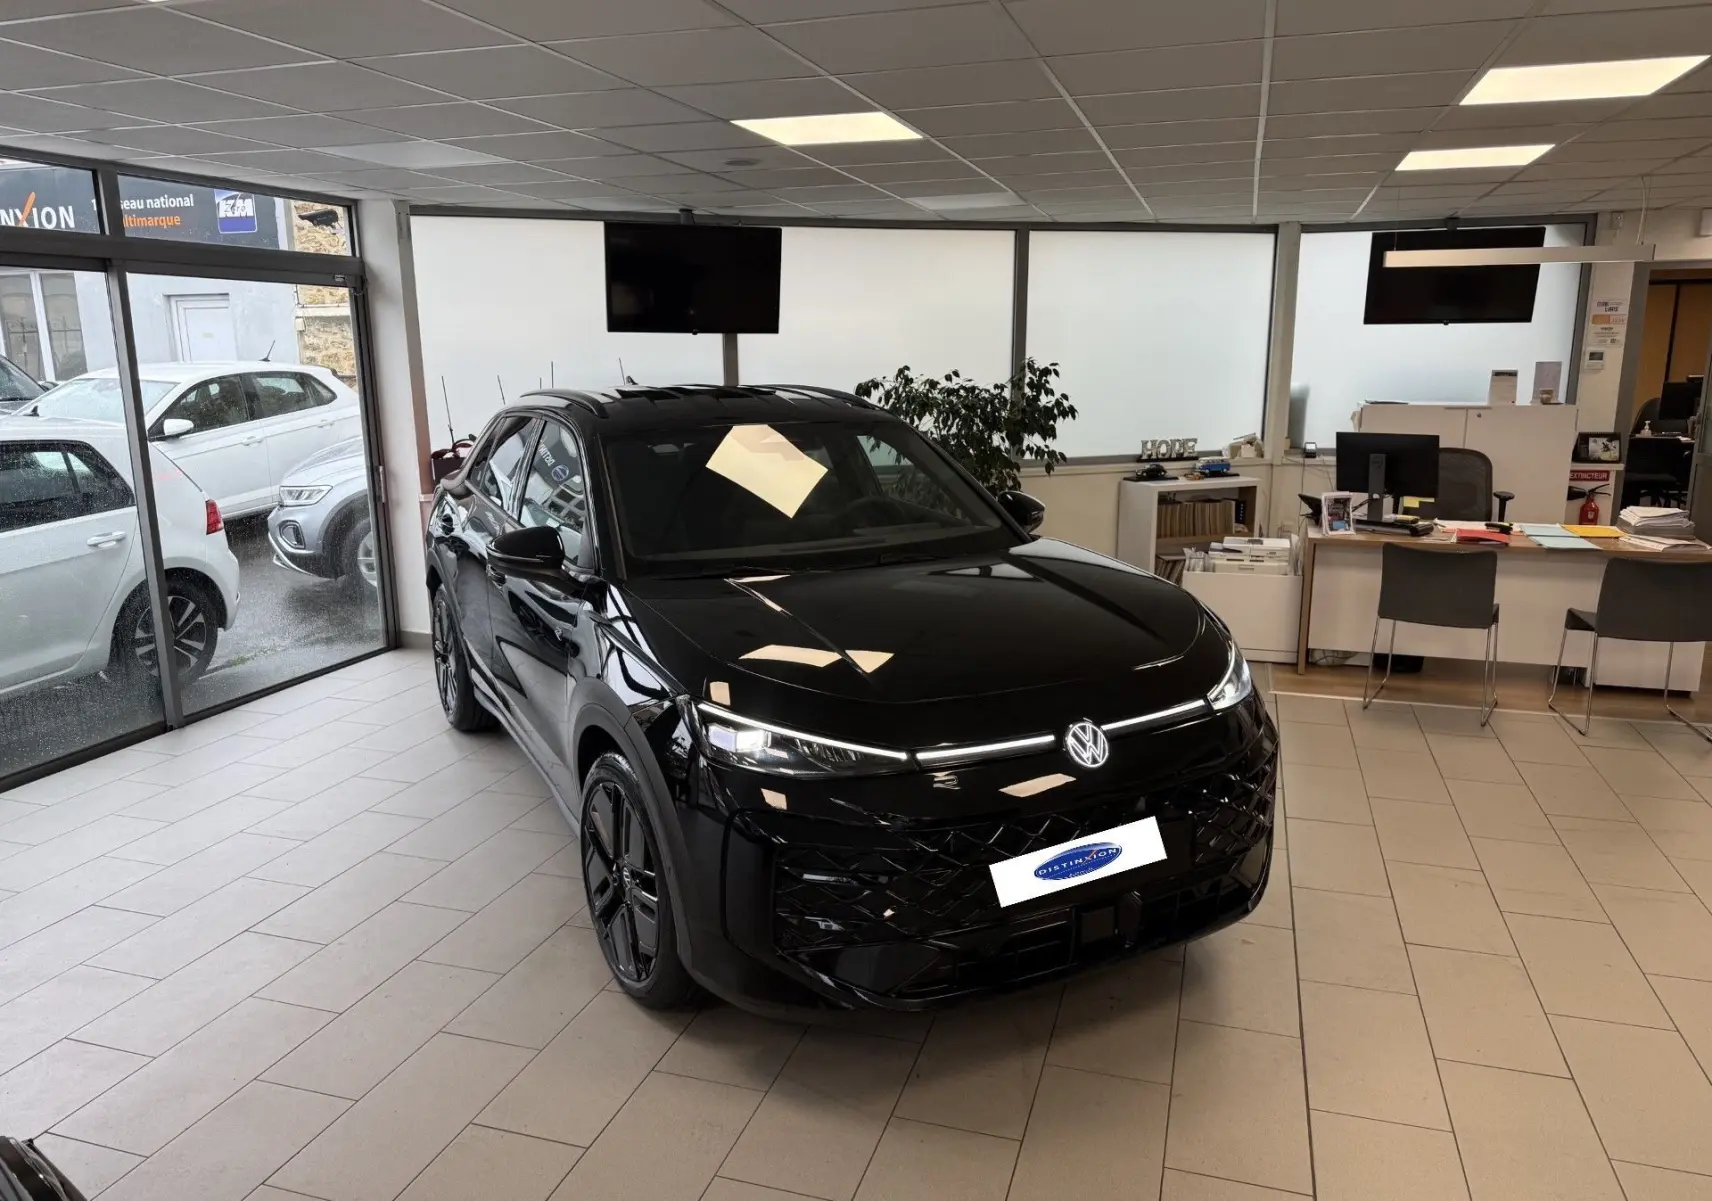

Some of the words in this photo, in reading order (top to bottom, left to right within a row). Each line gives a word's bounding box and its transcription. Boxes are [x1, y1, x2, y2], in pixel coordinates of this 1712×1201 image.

[146, 194, 194, 209] national
[1141, 438, 1198, 460] HOPE
[1570, 471, 1608, 480] EXTINCTEUR
[1066, 722, 1108, 767] VW
